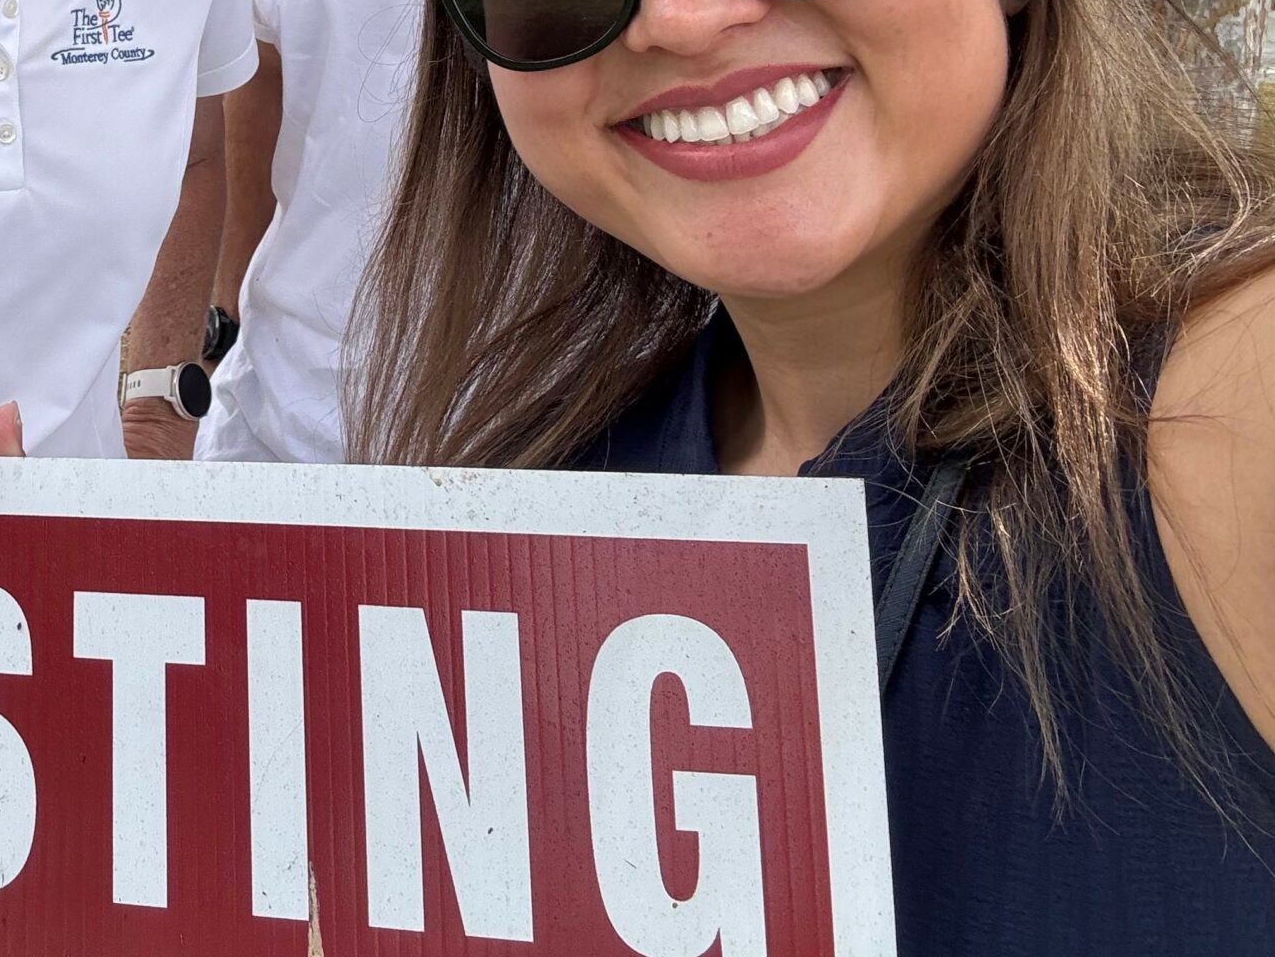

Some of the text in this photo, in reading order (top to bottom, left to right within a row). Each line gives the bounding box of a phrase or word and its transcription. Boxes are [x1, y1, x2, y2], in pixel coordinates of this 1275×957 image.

[71, 8, 98, 27] The
[73, 27, 102, 45] First
[61, 47, 146, 65] Monterey County
